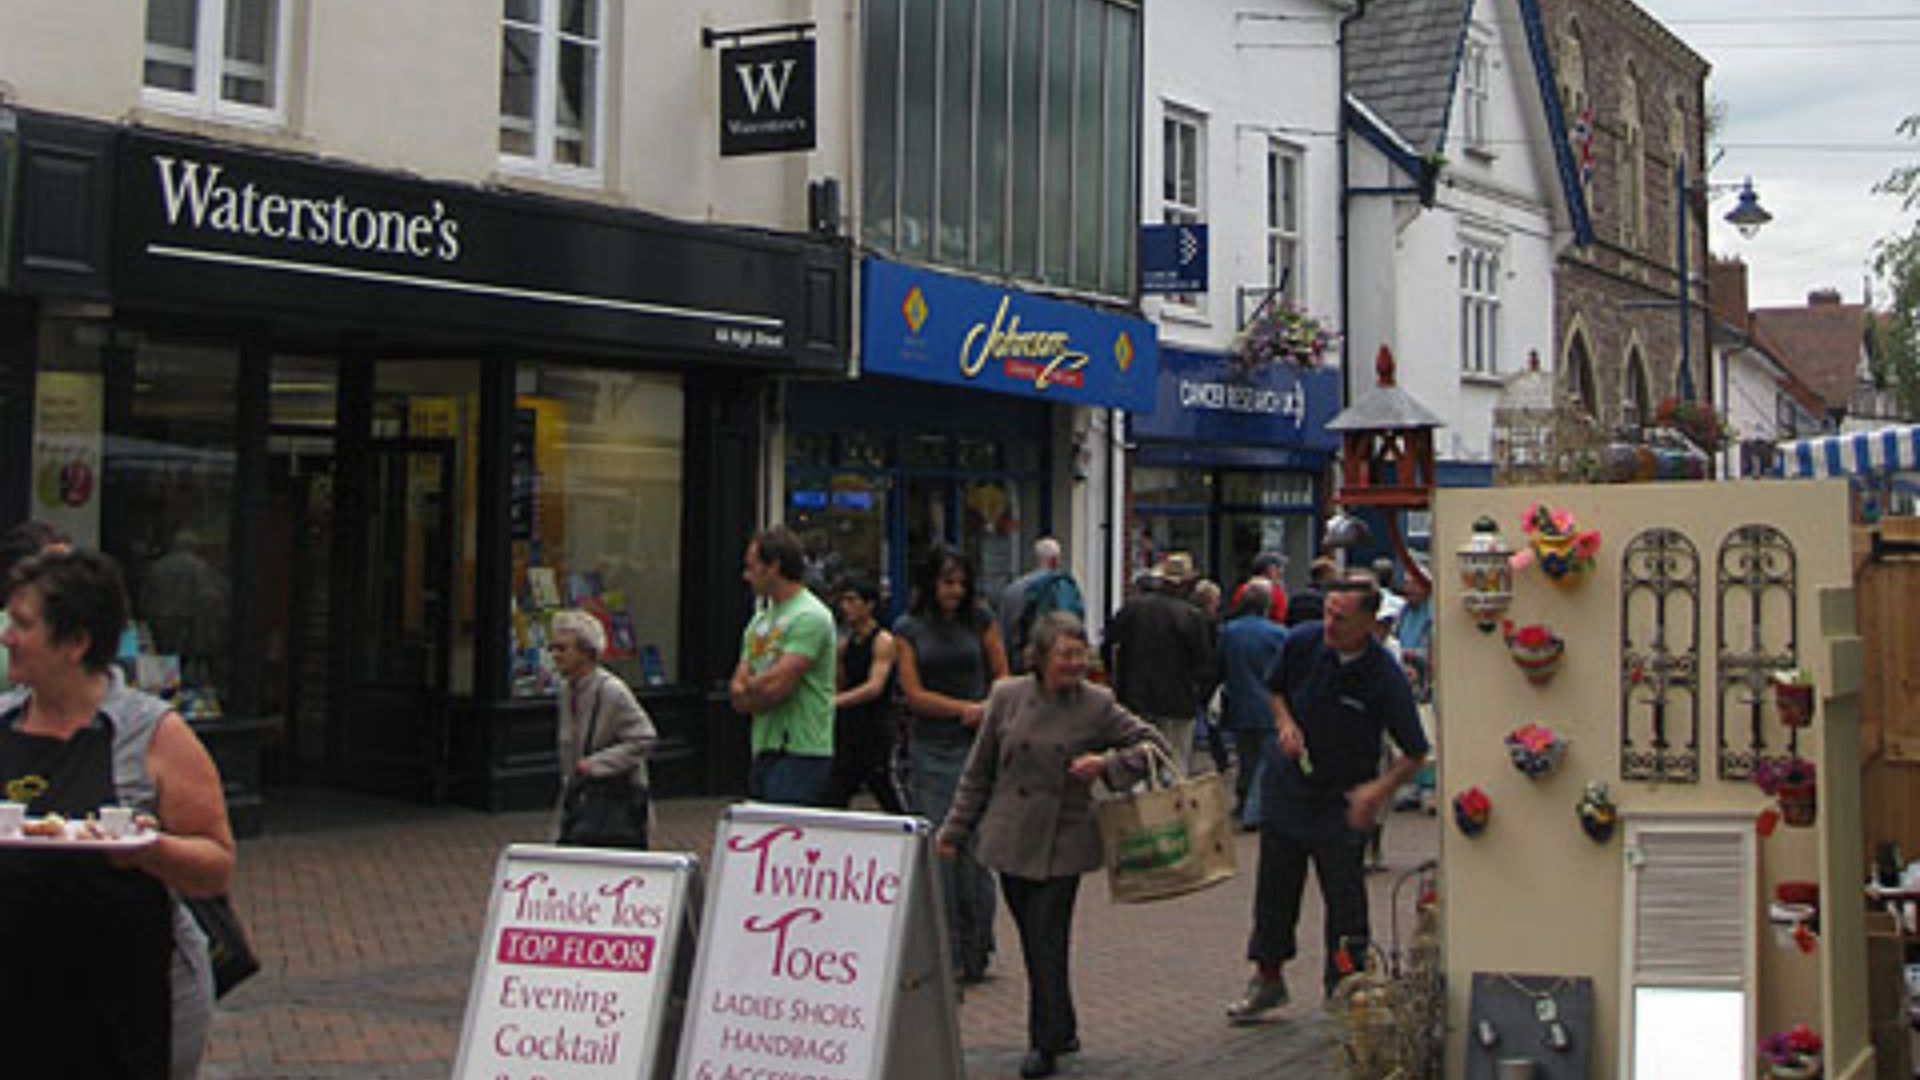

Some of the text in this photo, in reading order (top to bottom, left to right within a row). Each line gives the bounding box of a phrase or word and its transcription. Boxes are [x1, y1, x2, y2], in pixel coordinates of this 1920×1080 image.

[734, 59, 797, 114] W
[154, 155, 459, 261] Waterstone's
[1180, 380, 1225, 408] CANCER
[1227, 384, 1280, 413] RESEARCH
[727, 824, 900, 905] Twinkle
[503, 872, 664, 929] Twinkle Toes
[508, 932, 647, 969] TOP FLOOR
[743, 908, 859, 985] Toes
[712, 991, 784, 1021] LADIES
[494, 1023, 621, 1065] Cocktail
[720, 1027, 849, 1064] HANDBAGS
